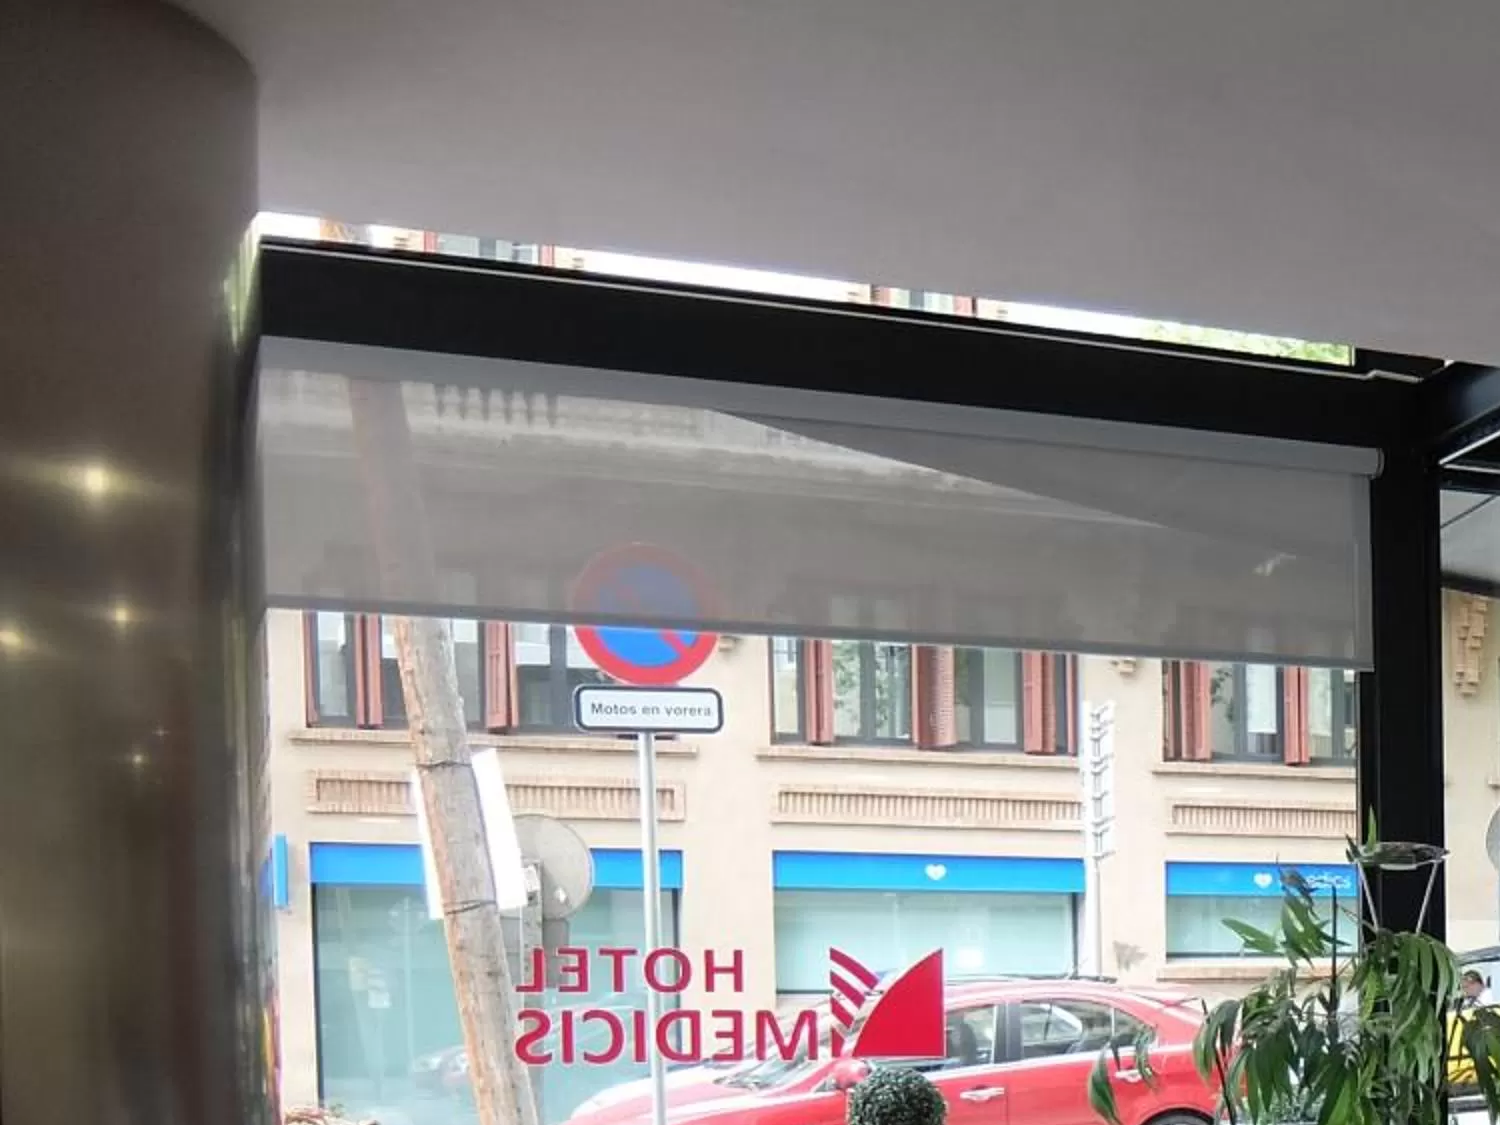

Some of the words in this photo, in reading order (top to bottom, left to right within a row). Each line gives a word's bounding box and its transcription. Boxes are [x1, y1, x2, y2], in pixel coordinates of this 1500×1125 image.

[591, 702, 637, 715] Motos
[641, 705, 660, 716] en
[665, 705, 712, 717] vorera
